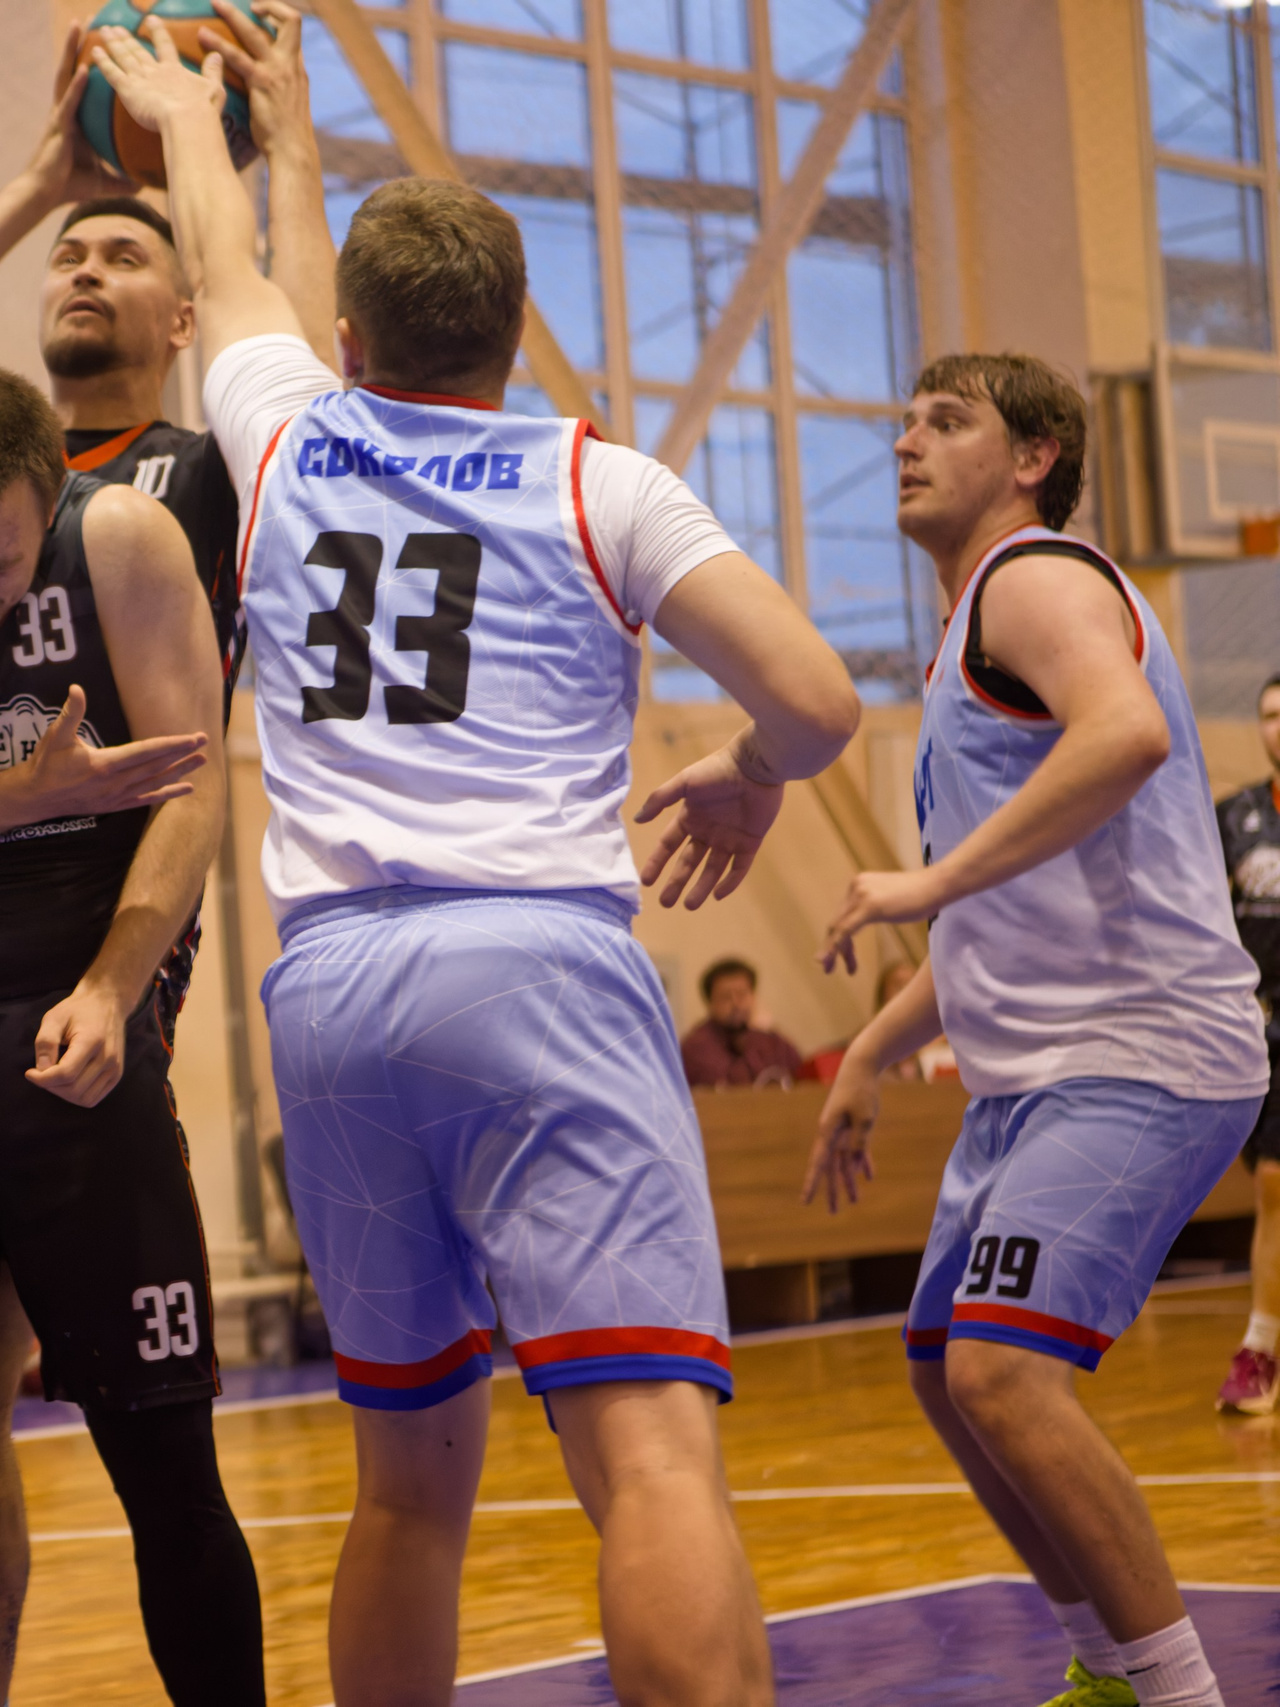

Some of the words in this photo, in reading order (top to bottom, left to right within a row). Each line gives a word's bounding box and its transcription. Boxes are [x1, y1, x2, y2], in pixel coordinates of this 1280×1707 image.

[132, 454, 176, 499] 10
[12, 586, 77, 667] 33
[301, 531, 482, 725] 33
[966, 1236, 1040, 1298] 99
[132, 1281, 198, 1361] 33
